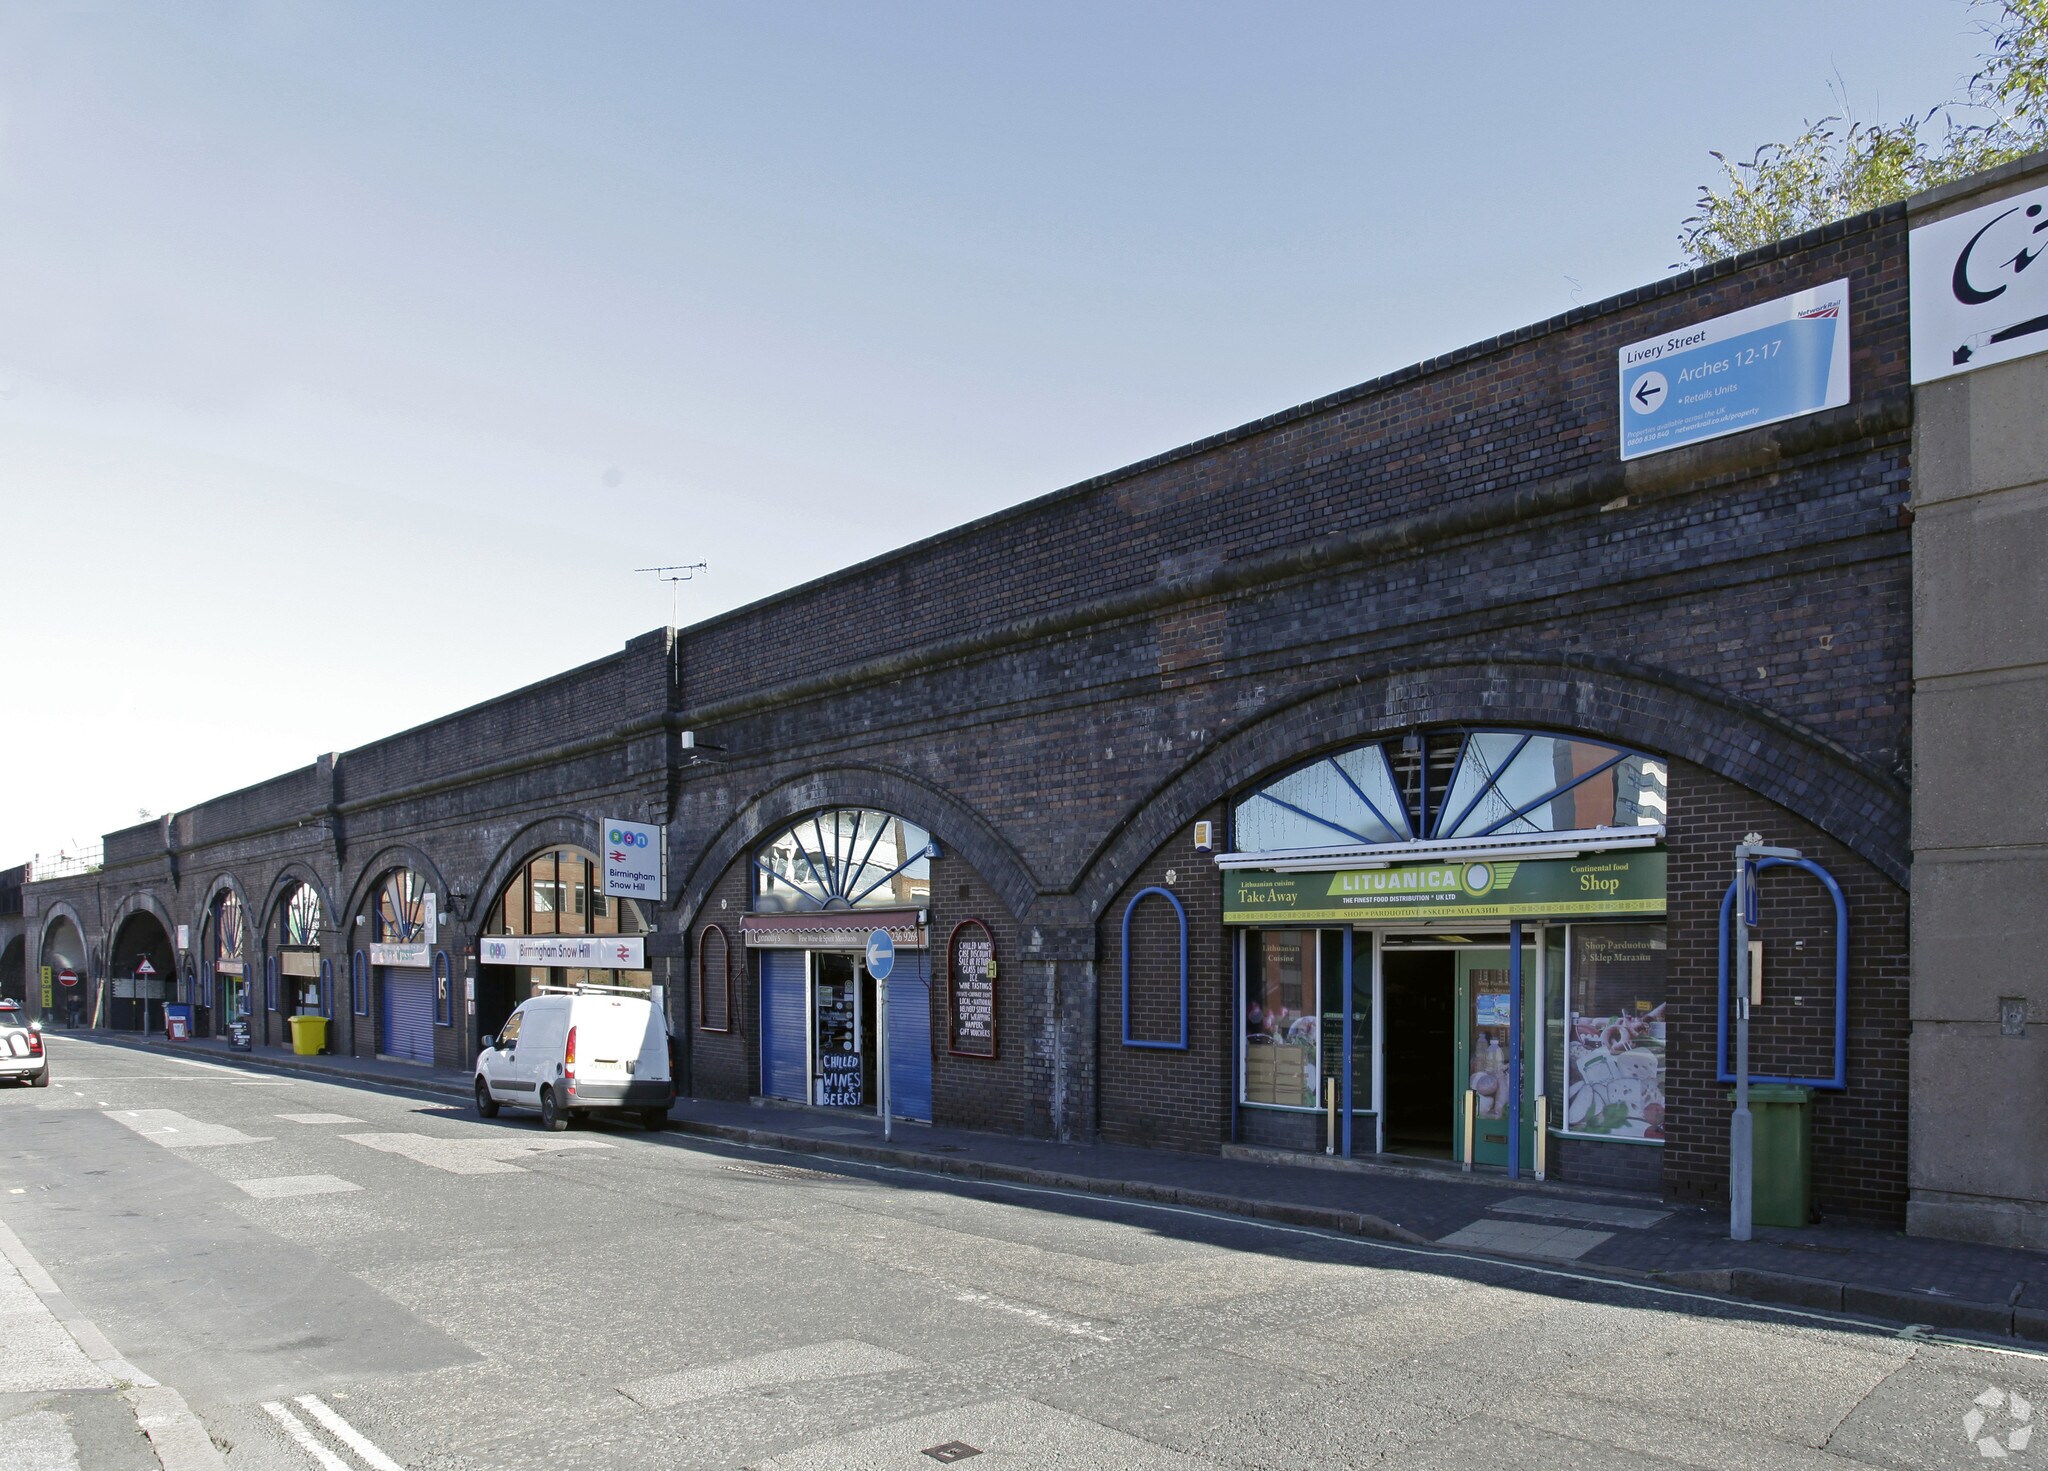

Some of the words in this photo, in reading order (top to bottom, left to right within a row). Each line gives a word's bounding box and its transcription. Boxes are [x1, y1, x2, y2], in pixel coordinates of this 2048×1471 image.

[1952, 204, 2048, 305] Ci
[1627, 345, 1663, 364] Livery
[1667, 330, 1706, 352] Street
[1678, 361, 1729, 384] Arches
[1735, 340, 1782, 367] 12-17
[1684, 389, 1712, 405] Retails
[1715, 384, 1738, 396] Units
[1627, 427, 1656, 439] Properties
[1657, 419, 1684, 430] available
[1685, 414, 1703, 423] across
[1704, 410, 1716, 418] the
[1627, 436, 1643, 446] 0800
[1643, 432, 1656, 442] 830
[1570, 863, 1611, 873] Continental
[1613, 862, 1629, 871] food
[609, 868, 656, 882] Birmingham
[1343, 870, 1455, 891] LITUANICA
[610, 880, 631, 890] Snow
[633, 882, 646, 891] Hill
[1241, 880, 1273, 888] Lithuanian
[1274, 879, 1295, 887] cuisine
[1580, 873, 1620, 895] Shop
[1238, 889, 1265, 904] Take
[1267, 888, 1298, 906] Away
[1373, 895, 1389, 903] FOOD
[1390, 894, 1430, 902] DISTRIBUTION
[1344, 910, 1363, 918] SHOP
[890, 931, 903, 942] 236
[520, 944, 557, 960] Birmingham
[558, 944, 577, 958] Snow
[579, 943, 591, 958] Hill
[1262, 944, 1300, 952] Lithuanian
[1585, 941, 1606, 951] Shop
[958, 950, 969, 958] CASE
[970, 950, 991, 958] DISCOUNT
[1268, 954, 1295, 962] Cuisine
[1589, 953, 1612, 963] Sklep
[958, 957, 968, 966] SALE
[969, 974, 978, 982] ICE
[438, 977, 447, 1000] 15
[823, 1055, 859, 1069] CHILLED
[823, 1072, 861, 1088] WINES
[823, 1092, 861, 1106] BEERS!
